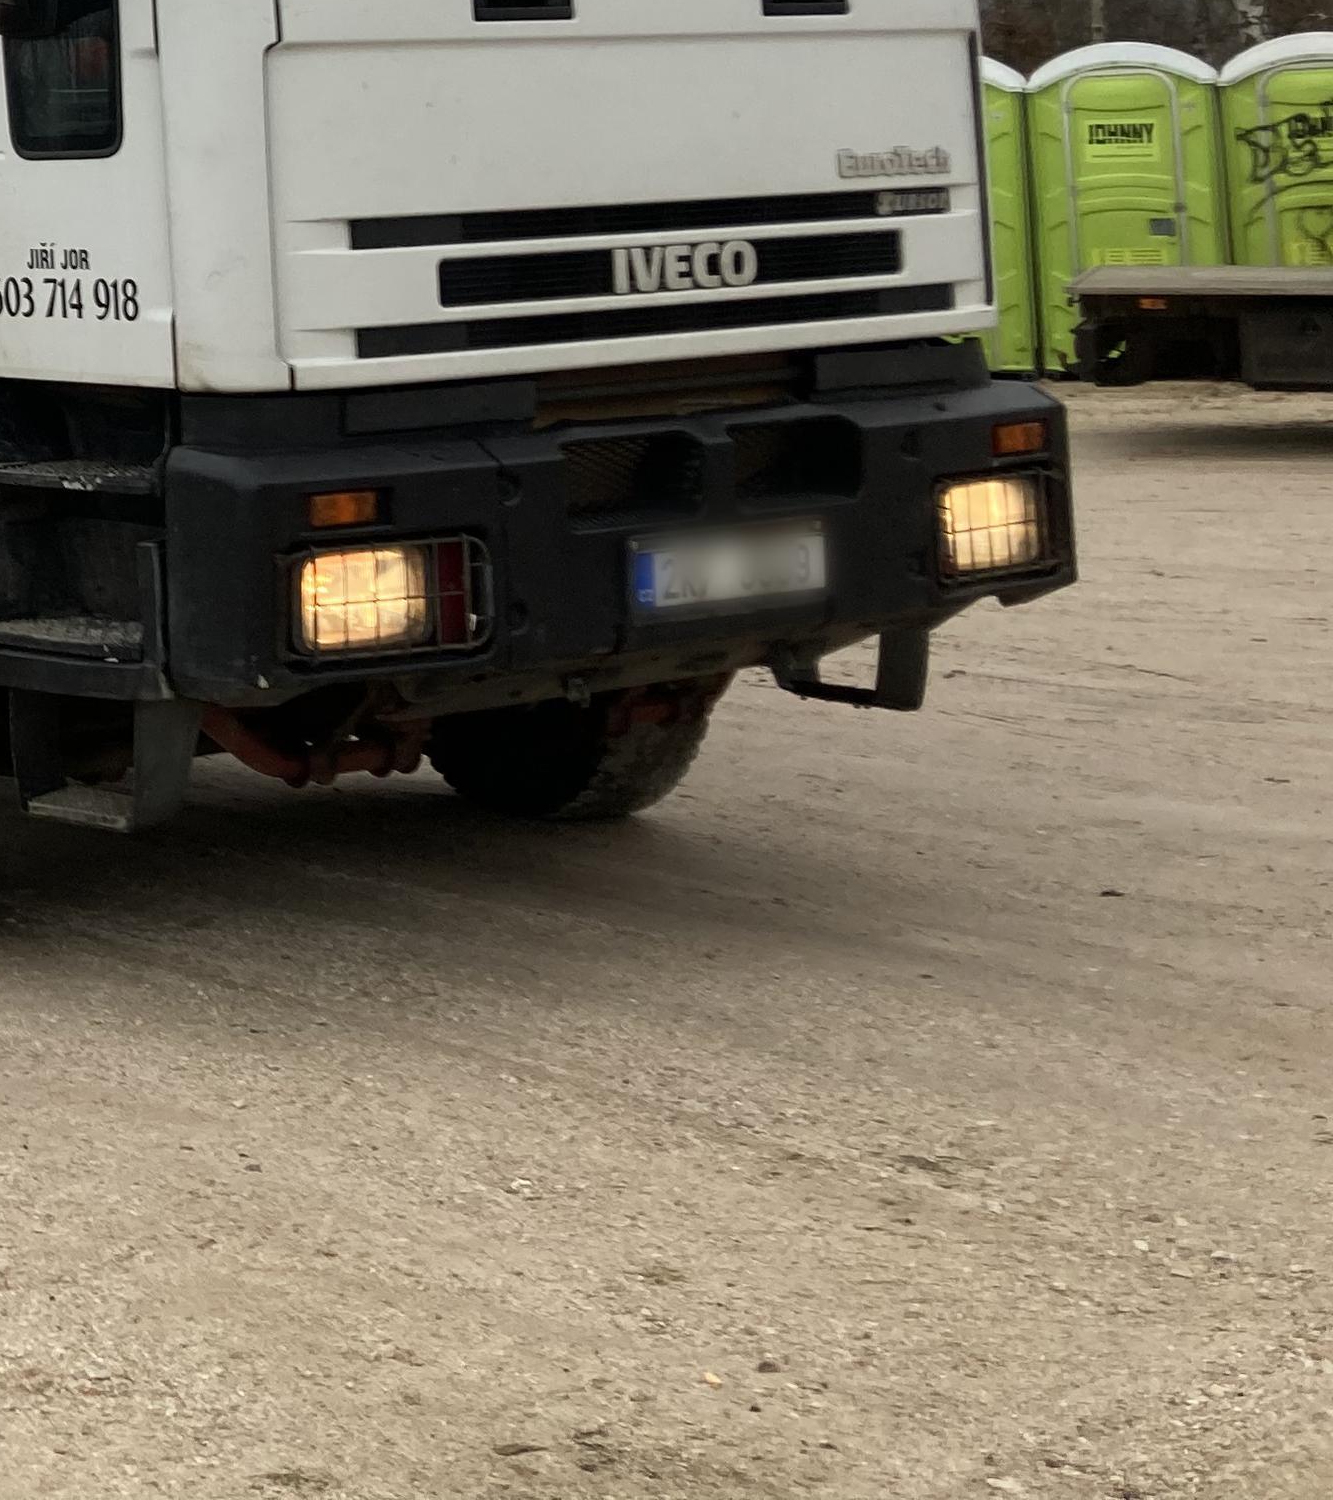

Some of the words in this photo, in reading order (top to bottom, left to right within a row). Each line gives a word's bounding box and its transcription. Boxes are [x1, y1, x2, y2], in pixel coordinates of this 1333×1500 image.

[1088, 123, 1155, 145] JOHNNY
[27, 241, 55, 269] JIŘÍ
[60, 249, 90, 270] JOR
[611, 240, 757, 294] IVECO
[42, 278, 83, 319] 714
[93, 279, 139, 321] 918
